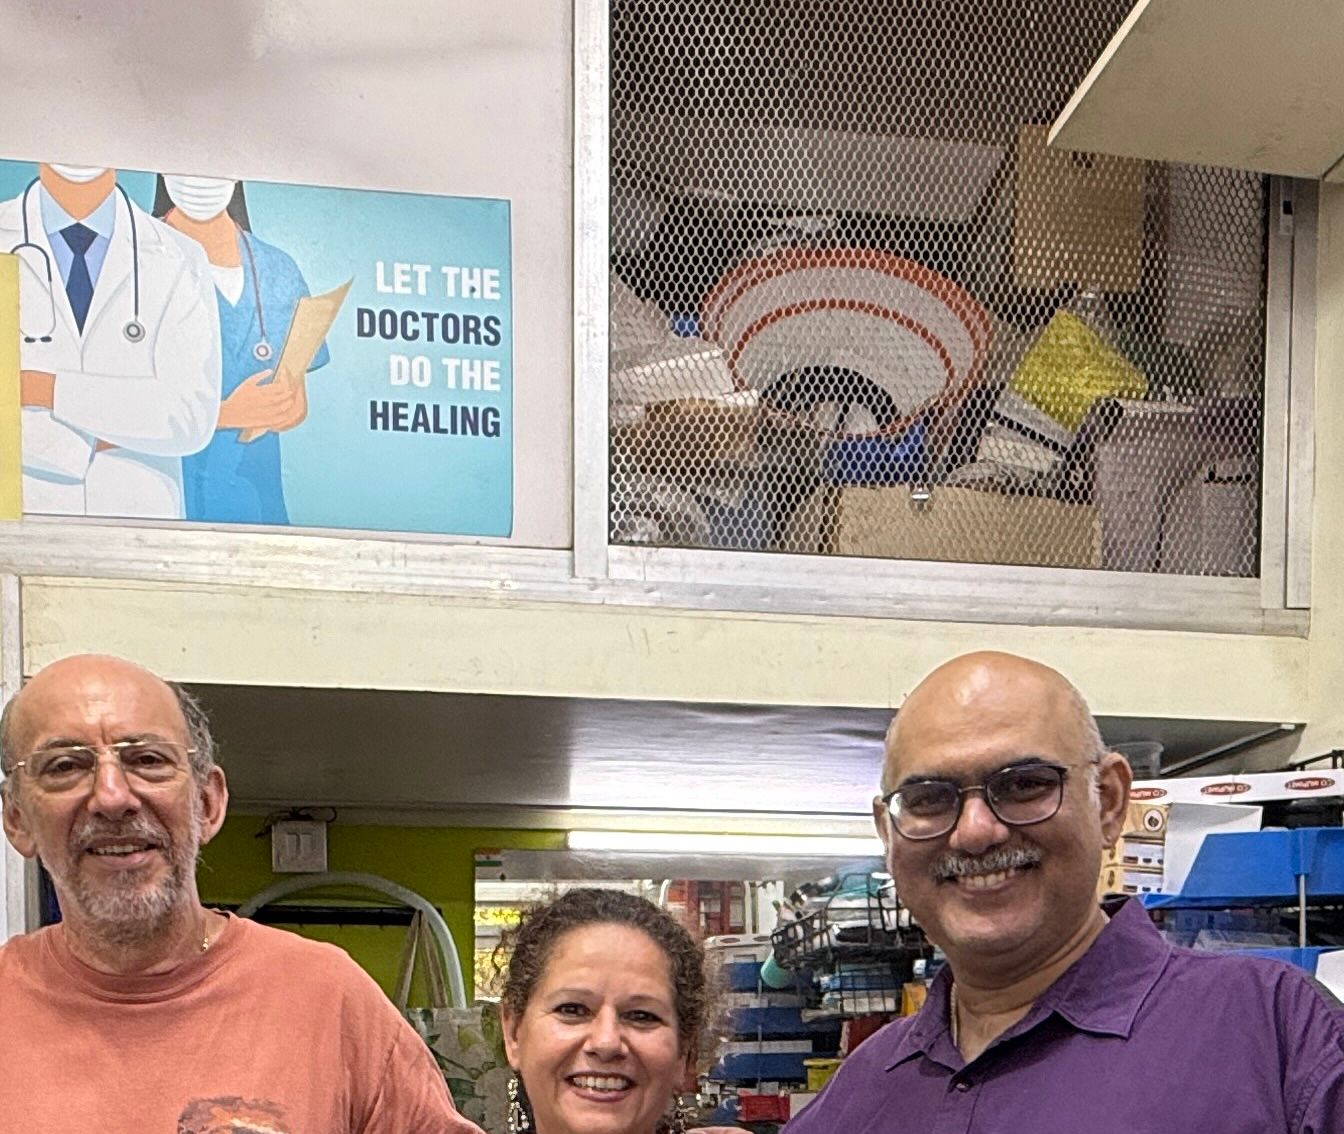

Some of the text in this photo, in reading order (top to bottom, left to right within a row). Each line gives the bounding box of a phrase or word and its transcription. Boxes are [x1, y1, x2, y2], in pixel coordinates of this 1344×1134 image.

[376, 261, 501, 300] LET THE
[357, 307, 501, 346] DOCTORS
[389, 354, 501, 391] DO THE
[370, 400, 501, 438] HEALING
